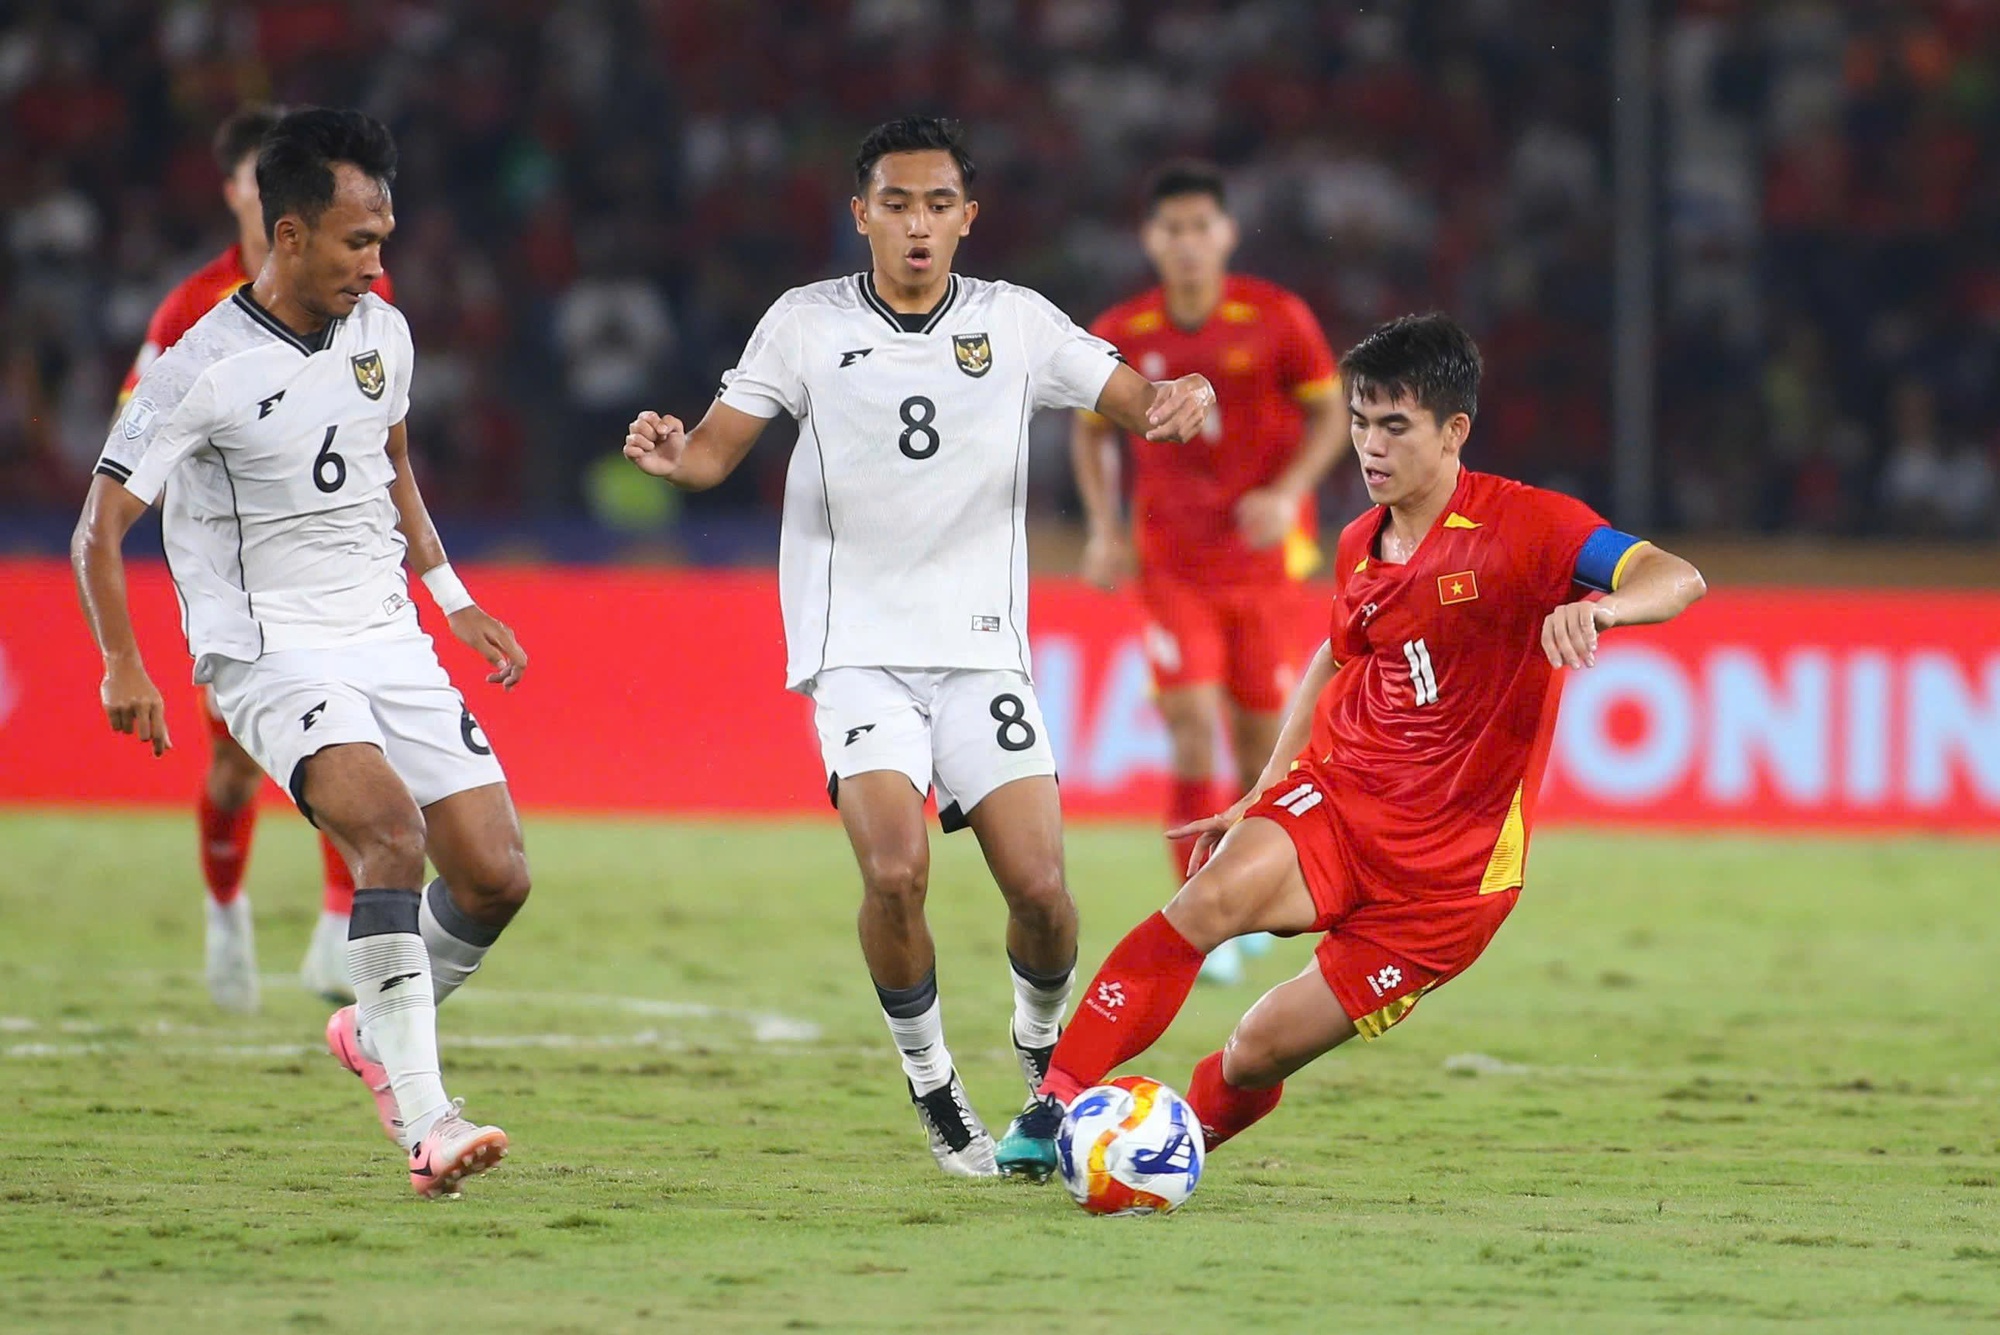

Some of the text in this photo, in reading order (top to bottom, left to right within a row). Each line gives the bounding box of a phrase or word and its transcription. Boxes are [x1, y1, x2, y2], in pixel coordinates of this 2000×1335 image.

[313, 425, 346, 493] 6
[899, 395, 940, 460] 8
[1403, 637, 1439, 707] 11
[990, 692, 1036, 752] 8
[1272, 783, 1323, 818] 11
